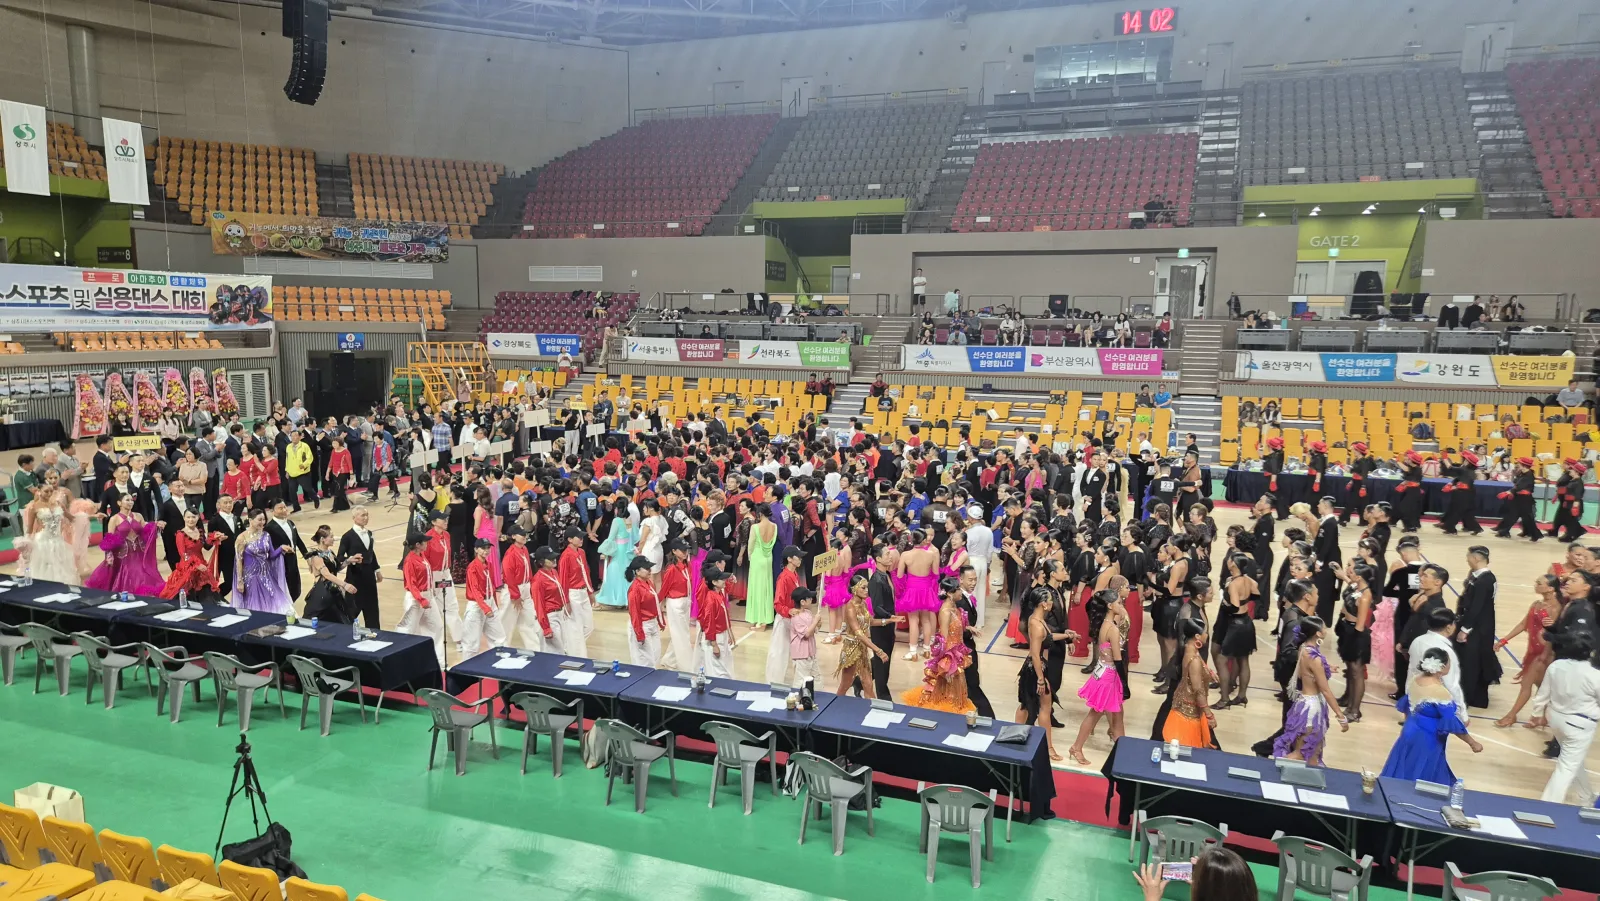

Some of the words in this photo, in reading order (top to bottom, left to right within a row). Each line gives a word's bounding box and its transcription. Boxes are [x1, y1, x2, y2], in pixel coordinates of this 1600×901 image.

[1122, 10, 1142, 34] 14
[1149, 7, 1175, 32] 02
[15, 140, 37, 149] 상주시
[1309, 235, 1349, 247] GATE
[1351, 235, 1360, 247] 2
[125, 249, 131, 261] 8
[130, 274, 165, 285] 아마추어
[171, 277, 204, 287] 생활체육
[0, 284, 71, 308] 스포츠
[74, 289, 91, 308] 및
[93, 286, 170, 310] 실용댄스
[171, 289, 206, 311] 대회
[503, 340, 532, 349] 경상북도
[540, 337, 556, 345] 선수단
[556, 337, 577, 345] 여러분을
[545, 345, 571, 353] 환영합다
[638, 345, 672, 355] 서울특별시
[699, 343, 720, 351] 여러분을
[803, 346, 822, 354] 선수단
[822, 346, 847, 355] 여러분을
[686, 350, 714, 358] 환영합니다
[760, 348, 792, 359] 전라북도
[809, 354, 840, 362] 환영합니다
[973, 351, 994, 359] 선수단
[994, 351, 1022, 359] 여러분을
[1104, 353, 1127, 362] 선수단
[1127, 353, 1158, 362] 여러분을
[979, 360, 1014, 368] 환영합니다
[1045, 355, 1094, 367] 부산광역시
[1328, 358, 1355, 367] 선수단
[1356, 358, 1391, 367] 여러분을
[1111, 362, 1149, 371] 환영합니다
[1261, 361, 1313, 371] 울산광역시
[1435, 364, 1480, 377] 강원도
[1500, 361, 1528, 371] 선수단
[1530, 361, 1568, 371] 여러분을
[1336, 368, 1381, 377] 환영합니다
[1508, 371, 1556, 381] 환영합니다
[117, 439, 158, 447] 울산광역시
[1163, 481, 1173, 489] 23
[815, 554, 837, 570] 부산광역시
